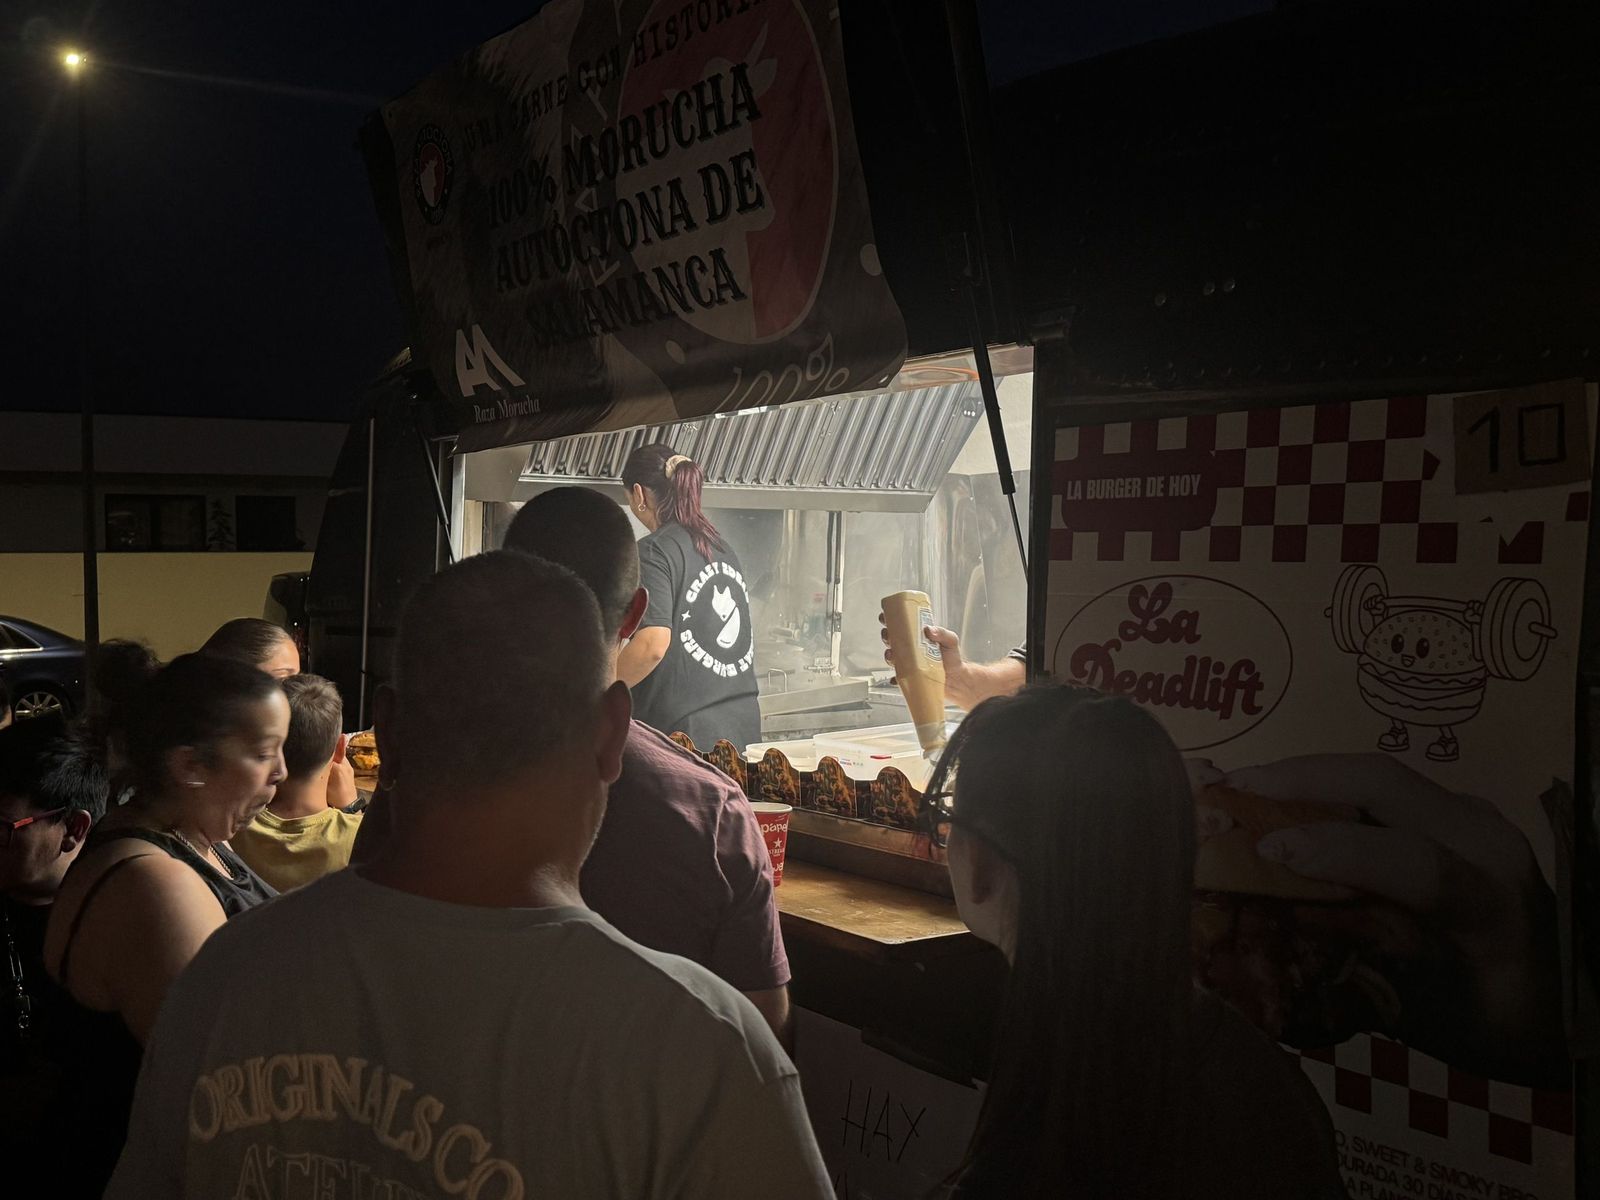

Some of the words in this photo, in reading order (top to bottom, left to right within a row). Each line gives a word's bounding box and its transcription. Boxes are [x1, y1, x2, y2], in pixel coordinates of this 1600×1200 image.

[488, 155, 556, 228] 100%
[564, 62, 761, 195] MORUCHA
[697, 148, 765, 225] DE
[472, 403, 496, 425] Raza
[496, 394, 541, 420] Morucha
[1468, 402, 1567, 473] 10
[1066, 480, 1082, 501] LA
[1086, 476, 1142, 500] BURGER
[1146, 475, 1166, 498] DE
[1169, 473, 1203, 497] HOY
[685, 561, 720, 603] CRAZY
[1118, 581, 1201, 644] La
[1070, 638, 1265, 720] Deadlift
[841, 1079, 927, 1162] HAY
[1352, 1136, 1410, 1169] SWEET
[1414, 1155, 1426, 1175] &
[1430, 1160, 1494, 1196] SMOKY
[1402, 1173, 1424, 1196] 30
